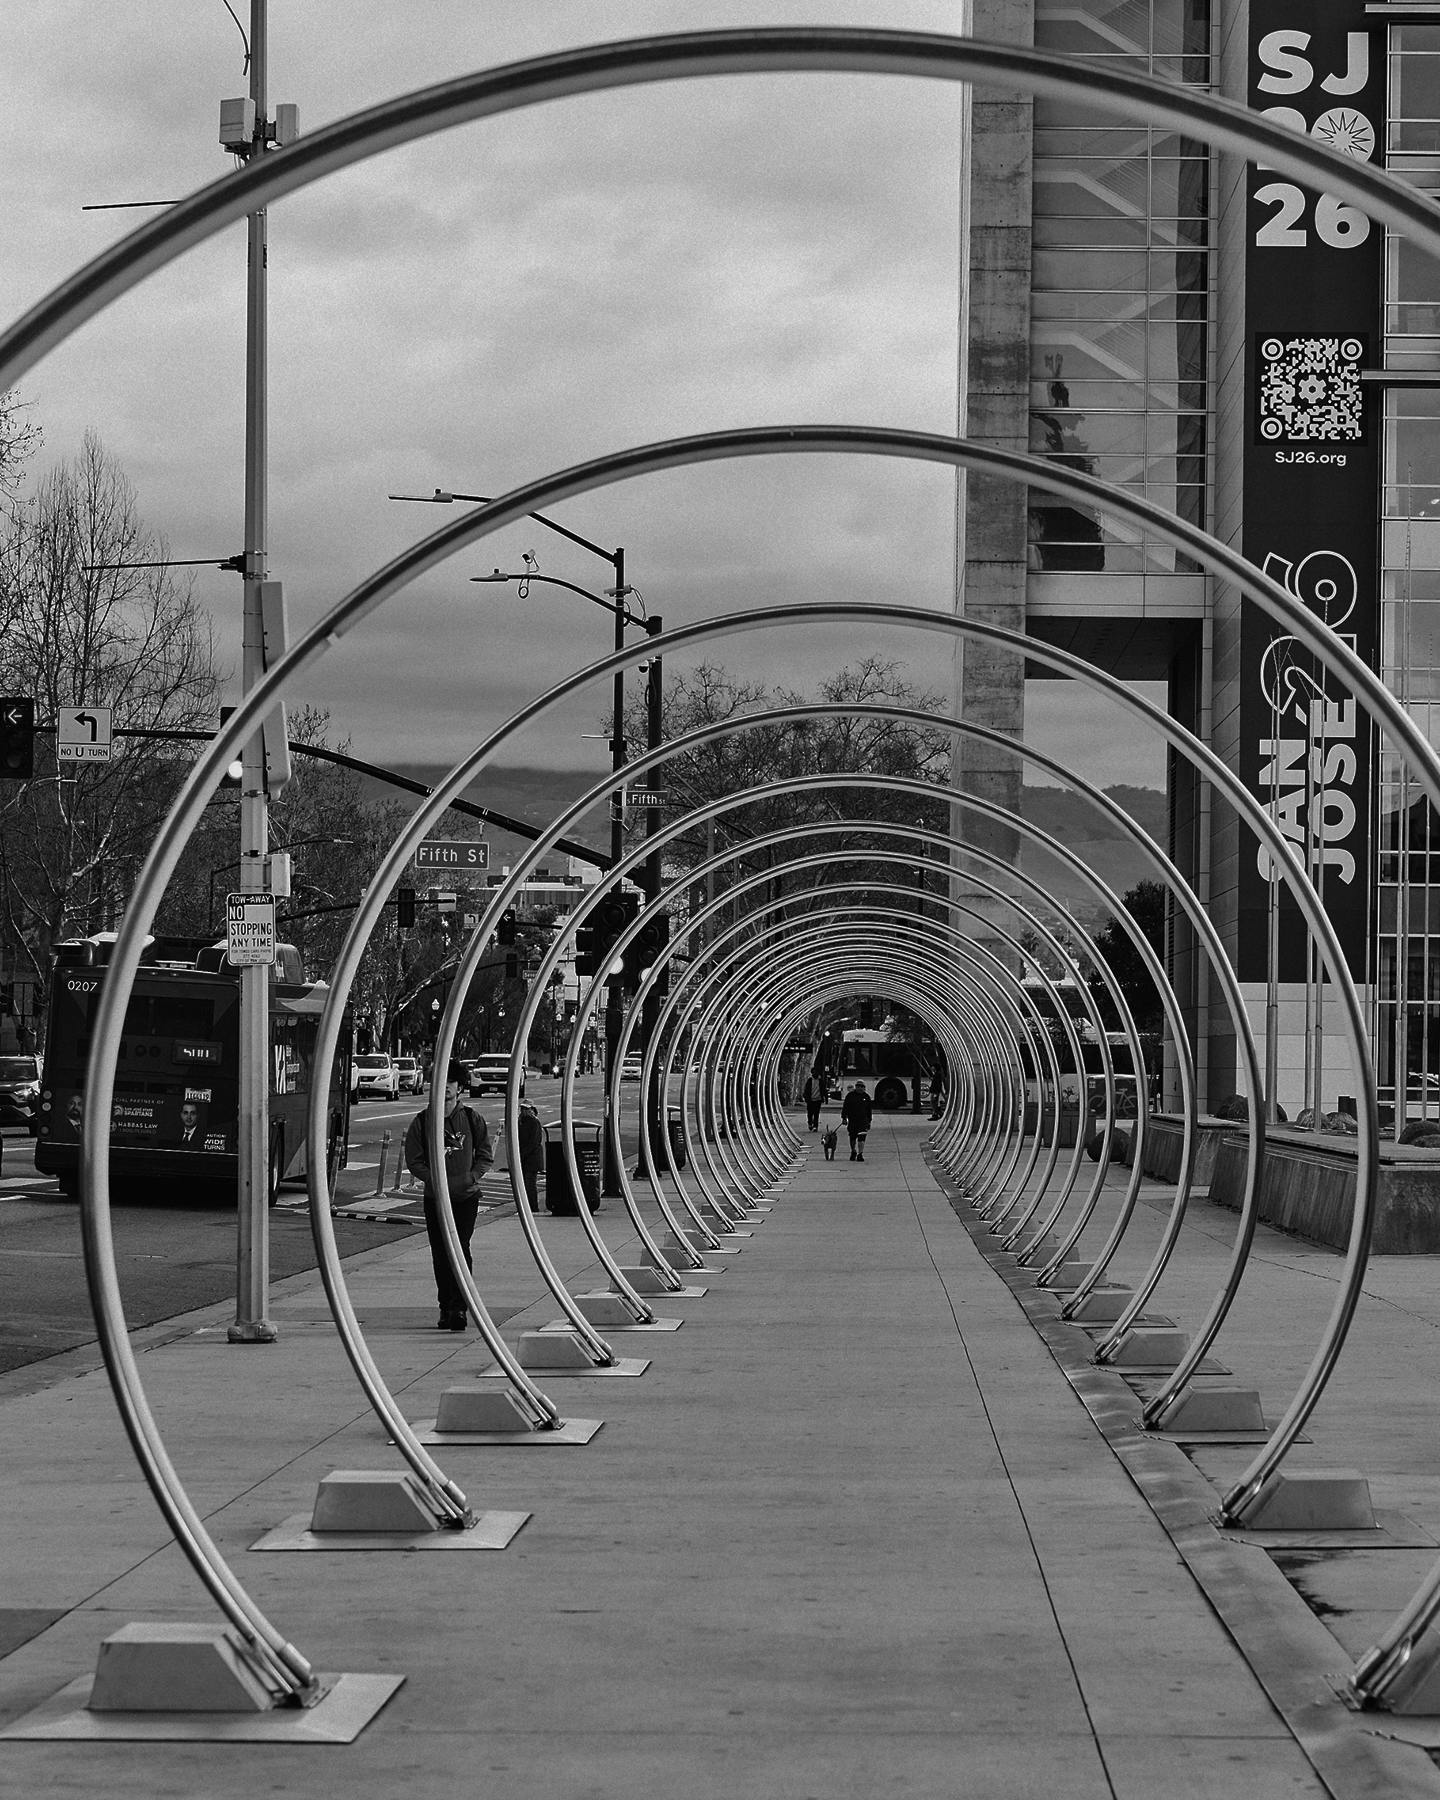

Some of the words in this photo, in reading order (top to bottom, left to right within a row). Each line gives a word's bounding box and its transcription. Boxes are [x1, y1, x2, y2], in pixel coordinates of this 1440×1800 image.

[1256, 29, 1369, 96] SJ
[1253, 182, 1371, 249] 26
[1274, 450, 1347, 467] SJ26.org
[60, 748, 72, 757] NO
[75, 746, 85, 758] U
[88, 748, 109, 757] TURN
[632, 794, 658, 805] Fifth
[419, 847, 459, 863] Fifth
[467, 848, 485, 863] St
[231, 895, 271, 904] TOW-AWAY
[229, 905, 244, 920] NO
[230, 922, 272, 936] STOPPING
[231, 938, 250, 948] ANY
[252, 937, 272, 947] TIME
[67, 980, 98, 993] 0207
